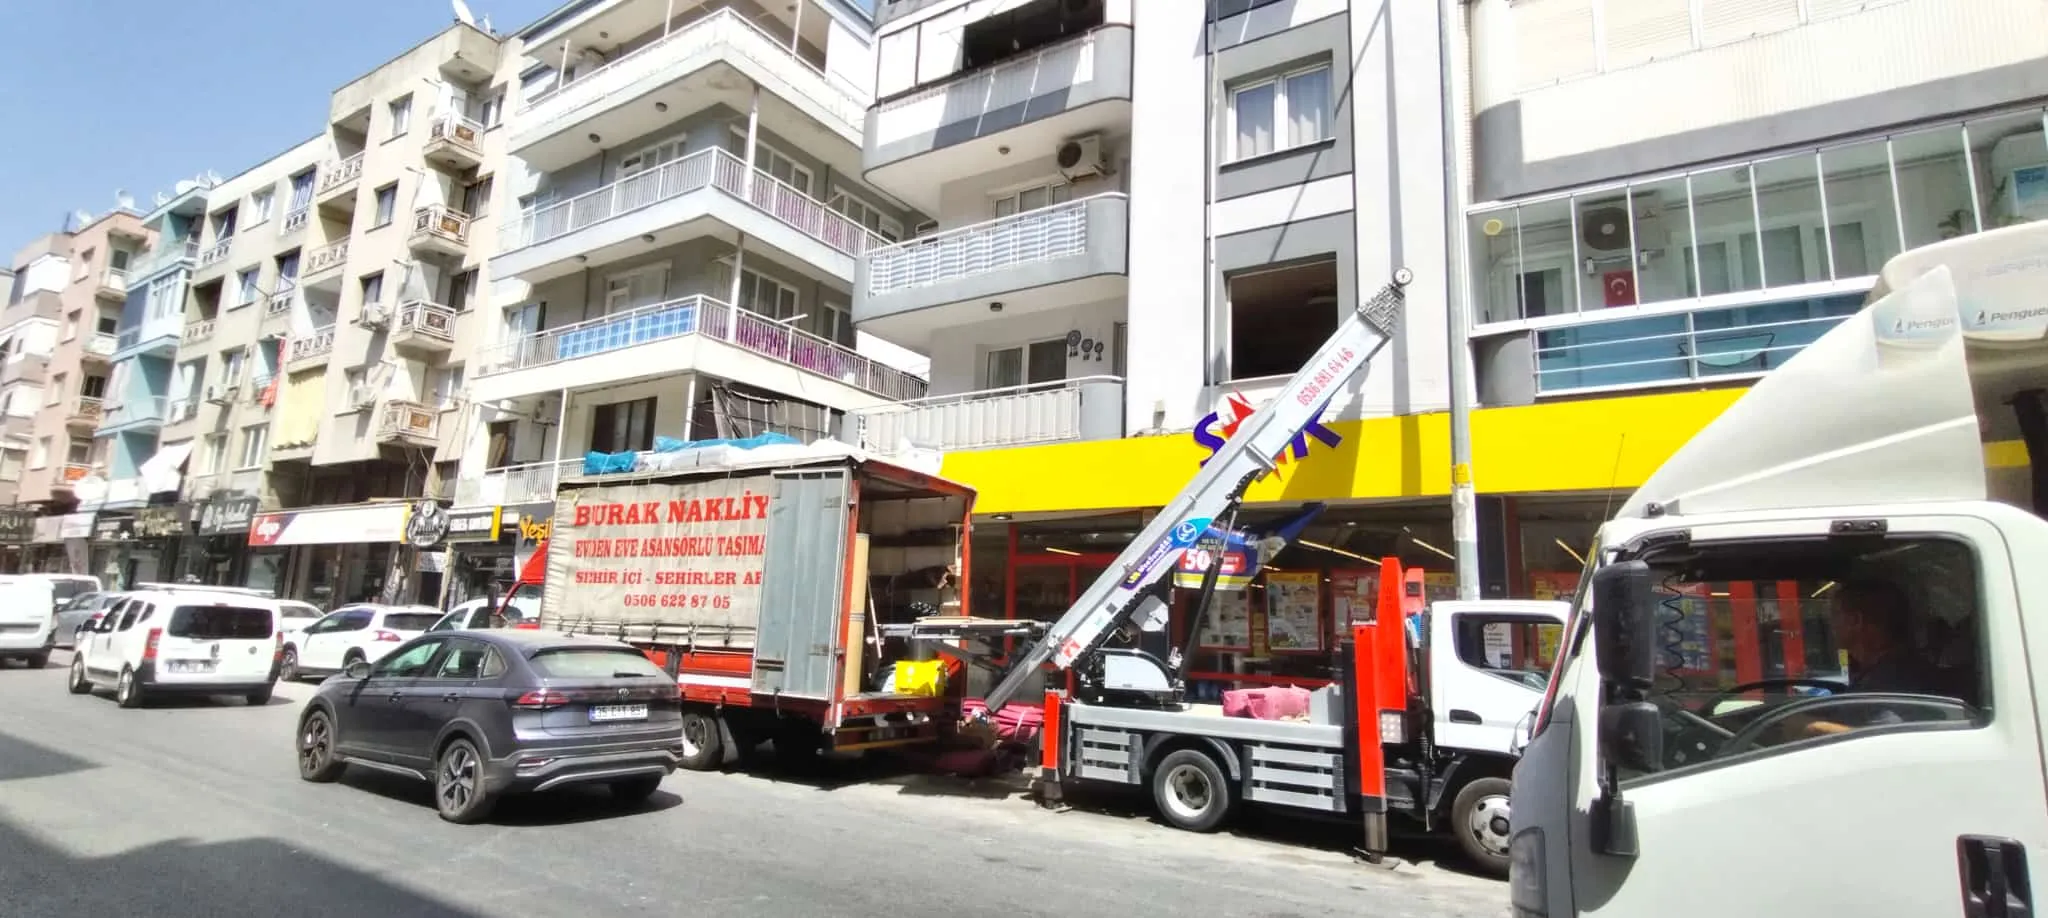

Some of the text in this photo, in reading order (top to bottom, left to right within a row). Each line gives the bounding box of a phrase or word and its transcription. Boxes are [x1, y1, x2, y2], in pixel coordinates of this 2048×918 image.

[575, 502, 661, 526] BURAK
[575, 539, 612, 559] EVDEN
[614, 538, 639, 558] EVE
[640, 533, 714, 558] ASANSÖRLÜ
[623, 594, 731, 610] 0506 622 87 05
